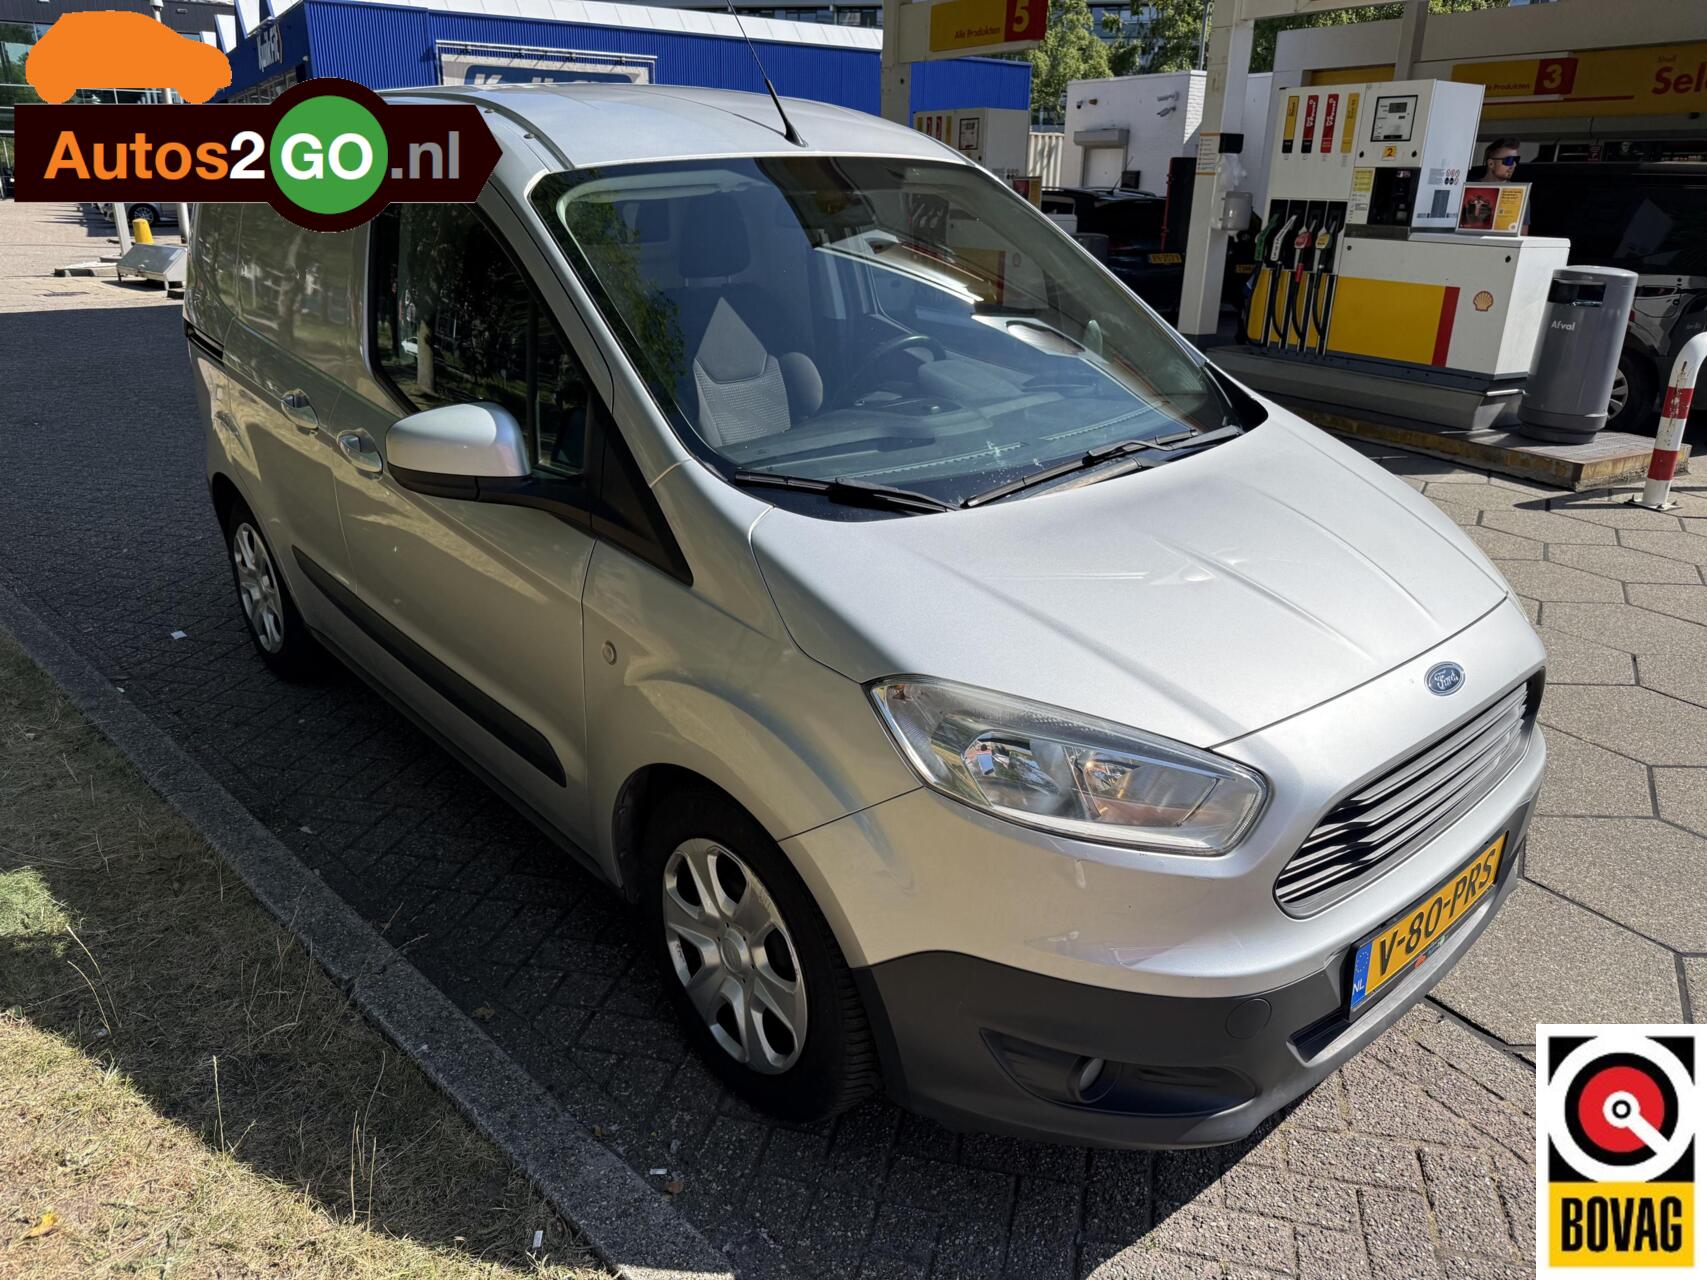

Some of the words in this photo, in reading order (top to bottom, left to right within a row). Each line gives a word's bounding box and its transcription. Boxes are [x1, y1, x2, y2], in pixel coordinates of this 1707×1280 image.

[1012, 0, 1030, 32] 5
[1543, 64, 1562, 88] 3
[1652, 62, 1707, 94] Sel
[1386, 147, 1394, 157] 2
[1551, 320, 1576, 331] Afval
[1434, 669, 1459, 690] Ford
[1380, 848, 1497, 976] V-80-PRS
[1352, 978, 1364, 995] NL
